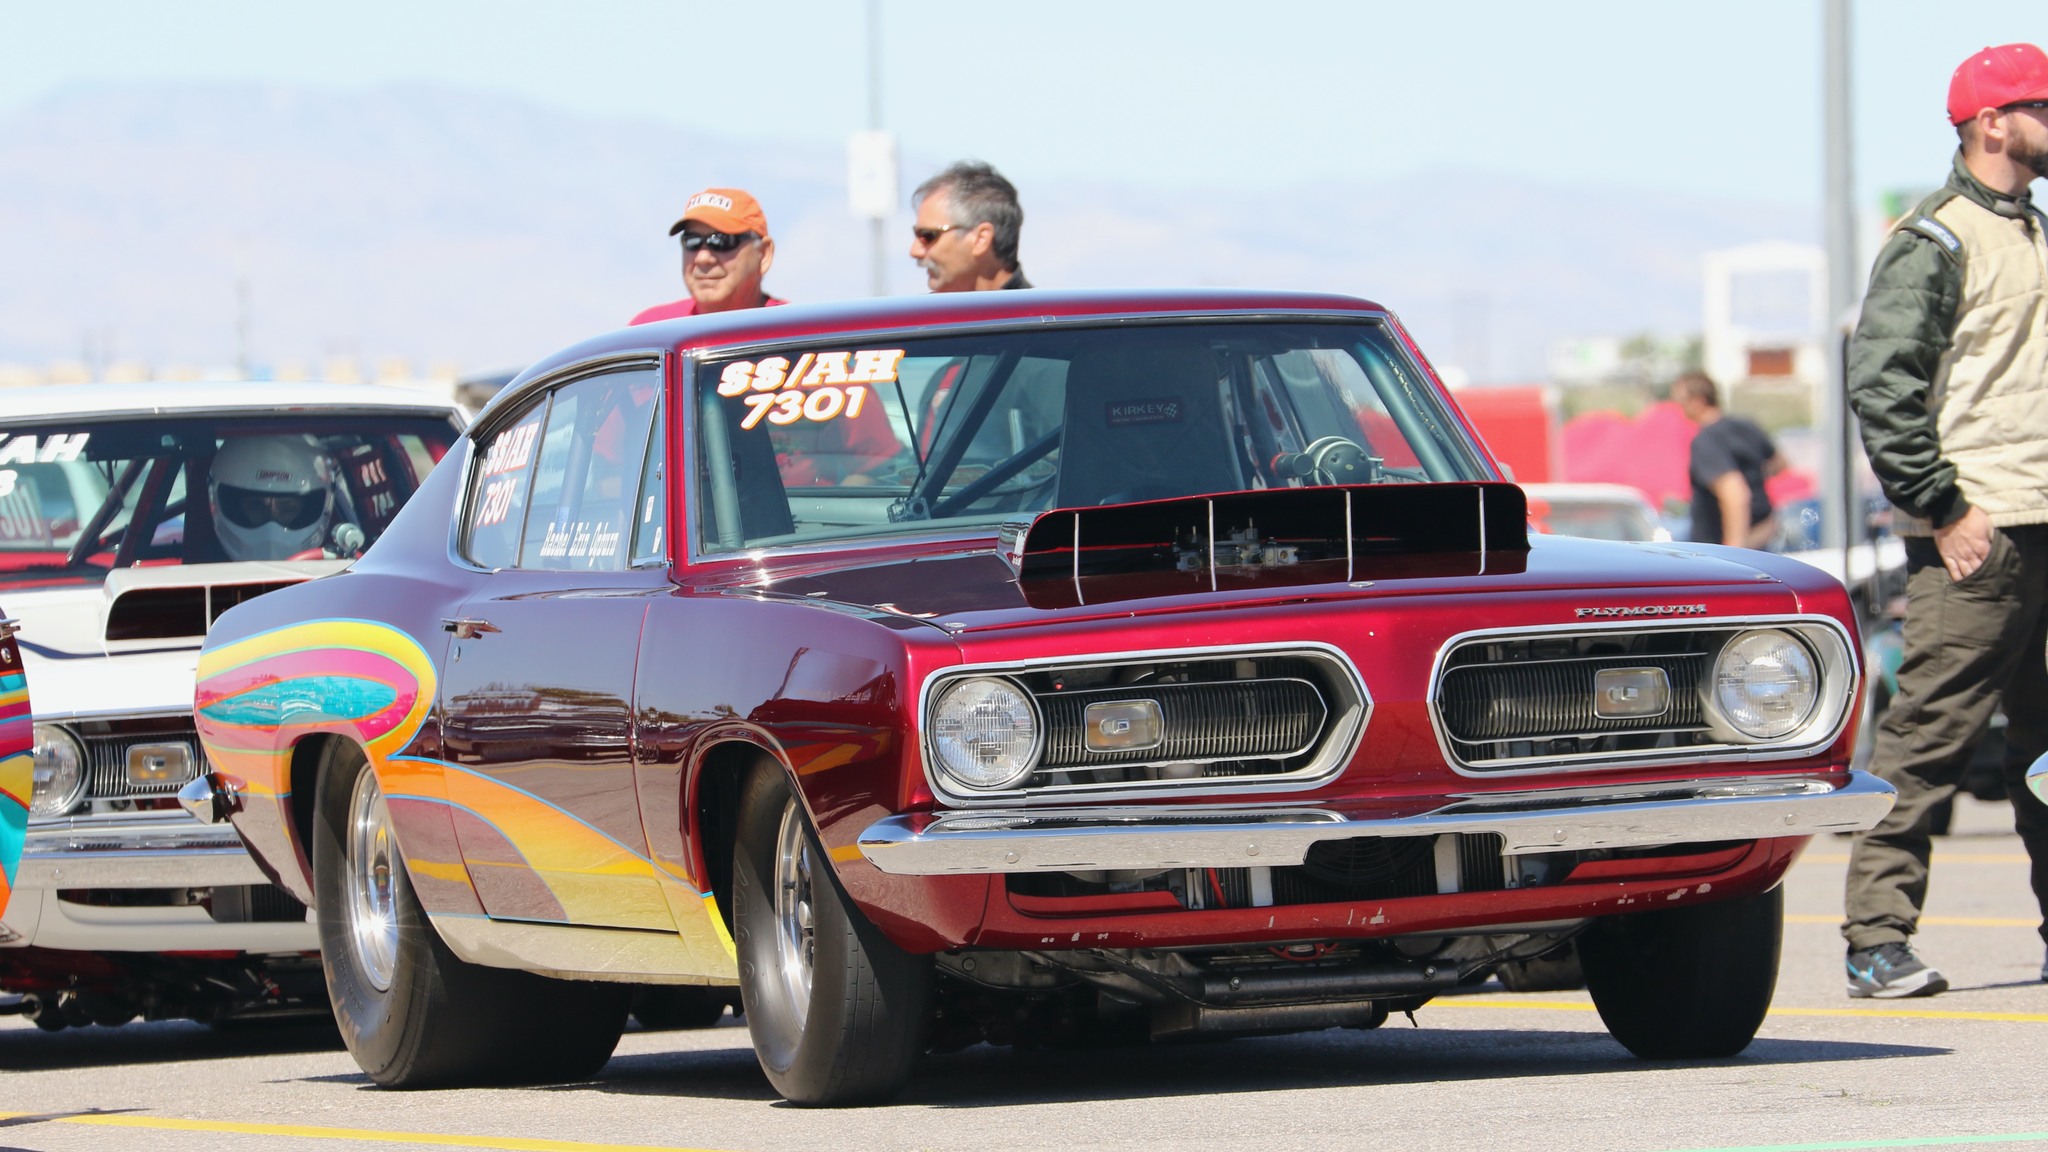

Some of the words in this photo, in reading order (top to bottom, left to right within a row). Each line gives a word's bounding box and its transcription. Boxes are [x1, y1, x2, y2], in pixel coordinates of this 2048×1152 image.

[717, 349, 905, 397] SS/AH
[740, 386, 867, 430] 7301
[1112, 404, 1164, 416] KIRKEY
[475, 478, 518, 529] 7301
[1574, 604, 1707, 617] PLYMOUTH
